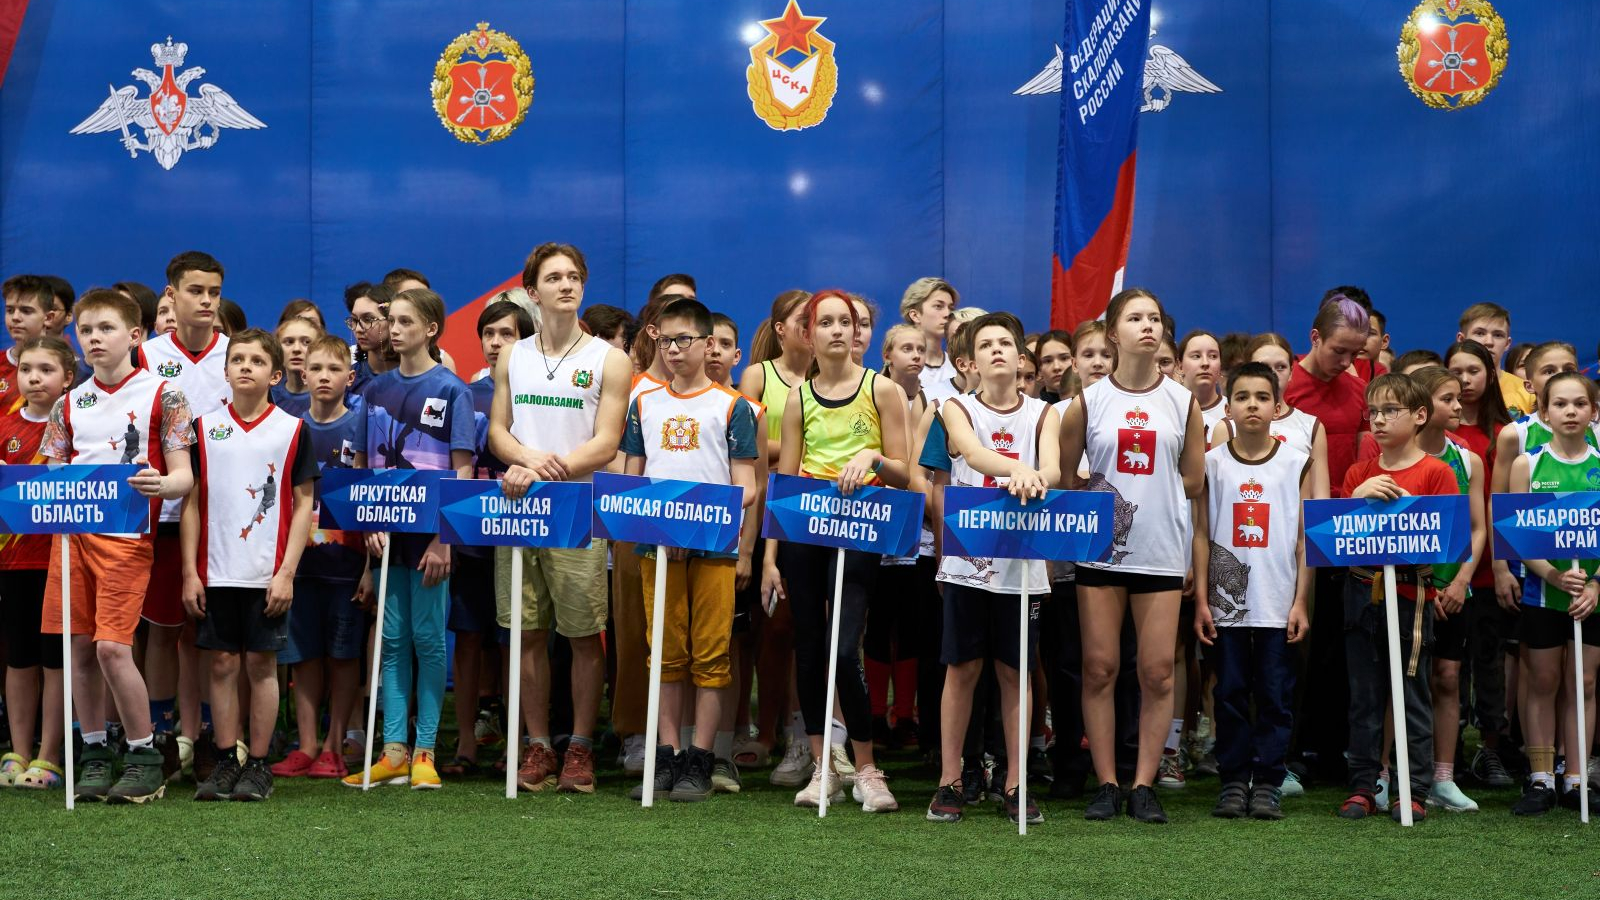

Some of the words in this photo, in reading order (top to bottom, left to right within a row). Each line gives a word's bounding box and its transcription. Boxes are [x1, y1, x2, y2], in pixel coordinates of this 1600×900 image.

[1070, 0, 1121, 73] ФЕДЕРАЦИ
[772, 70, 808, 94] ЦСКА
[1079, 58, 1124, 125] РОССИИ
[514, 394, 584, 410] СКАЛОЛАЗАНИЕ
[16, 480, 118, 500] ТЮМЕНСКАЯ
[349, 484, 427, 503] ИРКУТСКАЯ
[31, 504, 104, 524] ОБЛАСТЬ
[356, 505, 417, 524] ОБЛАСТЬ
[479, 495, 551, 516] ТОМСКАЯ
[600, 494, 662, 518] ОМСКАЯ
[664, 501, 732, 525] ОБЛАСТЬ
[800, 492, 892, 522] ПСКОВСКАЯ
[481, 517, 549, 537] ОБЛАСТЬ
[958, 508, 1051, 532] ПЕРМСКИЙ
[1054, 510, 1099, 534] КРАЙ
[1332, 511, 1441, 536] УДМУРТСКАЯ
[1515, 508, 1600, 527] ХАБАРОВС
[808, 516, 878, 542] ОБЛАСТЬ
[1554, 526, 1598, 549] КРАЙ
[1335, 534, 1442, 556] РЕСПУБЛИКА
